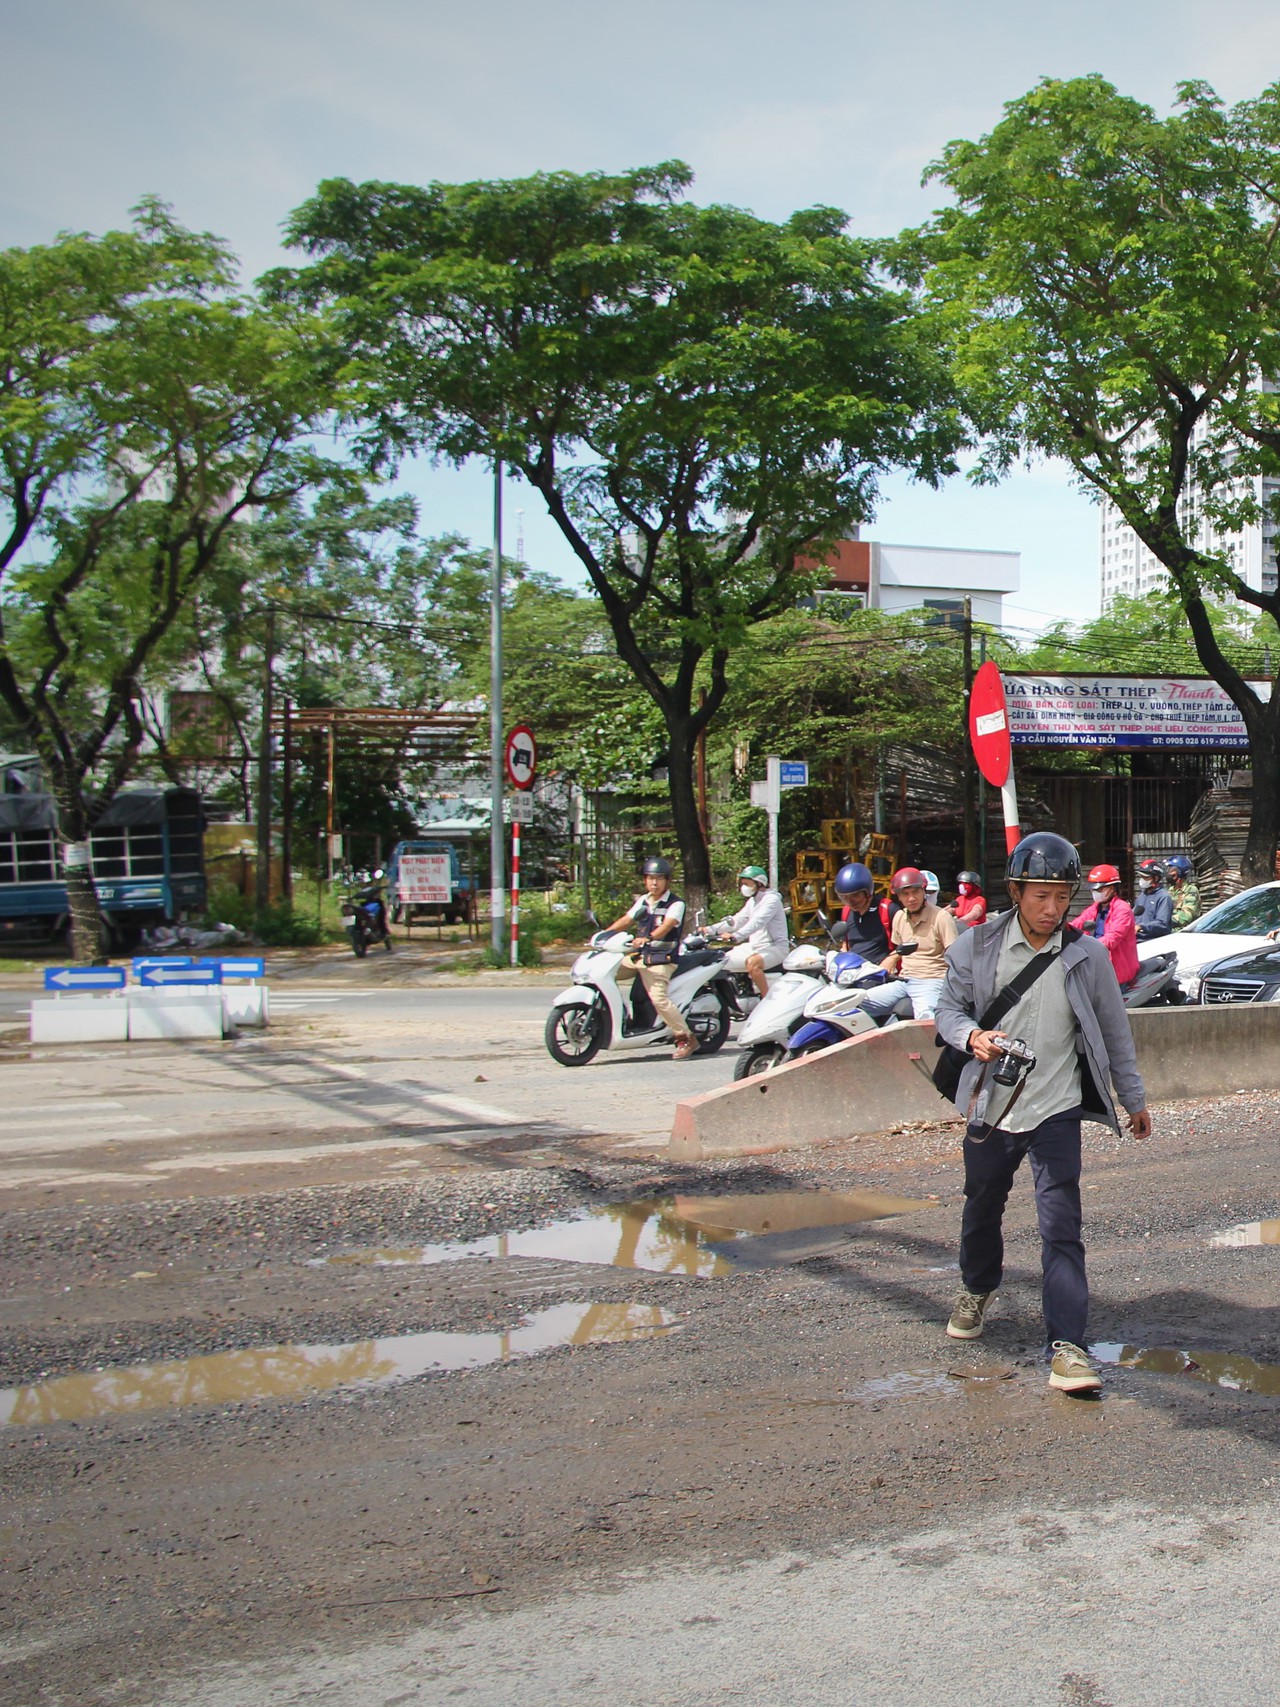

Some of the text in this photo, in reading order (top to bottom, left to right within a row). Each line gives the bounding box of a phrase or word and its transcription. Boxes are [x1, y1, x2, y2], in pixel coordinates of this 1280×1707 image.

[1032, 682, 1075, 696] HÀNG
[1080, 681, 1112, 697] SẮT
[1117, 684, 1157, 697] THÉP
[1012, 700, 1033, 709] MUA
[1052, 723, 1071, 731] THU
[1074, 723, 1096, 731] MUA
[1028, 733, 1046, 744] CẦU
[1047, 733, 1079, 744] NGUYỄN
[1079, 734, 1097, 744] VĂN
[1098, 733, 1116, 744] TRỖI
[1152, 737, 1164, 745] ĐT:
[1200, 737, 1214, 745] 619
[1220, 737, 1238, 745] 0935
